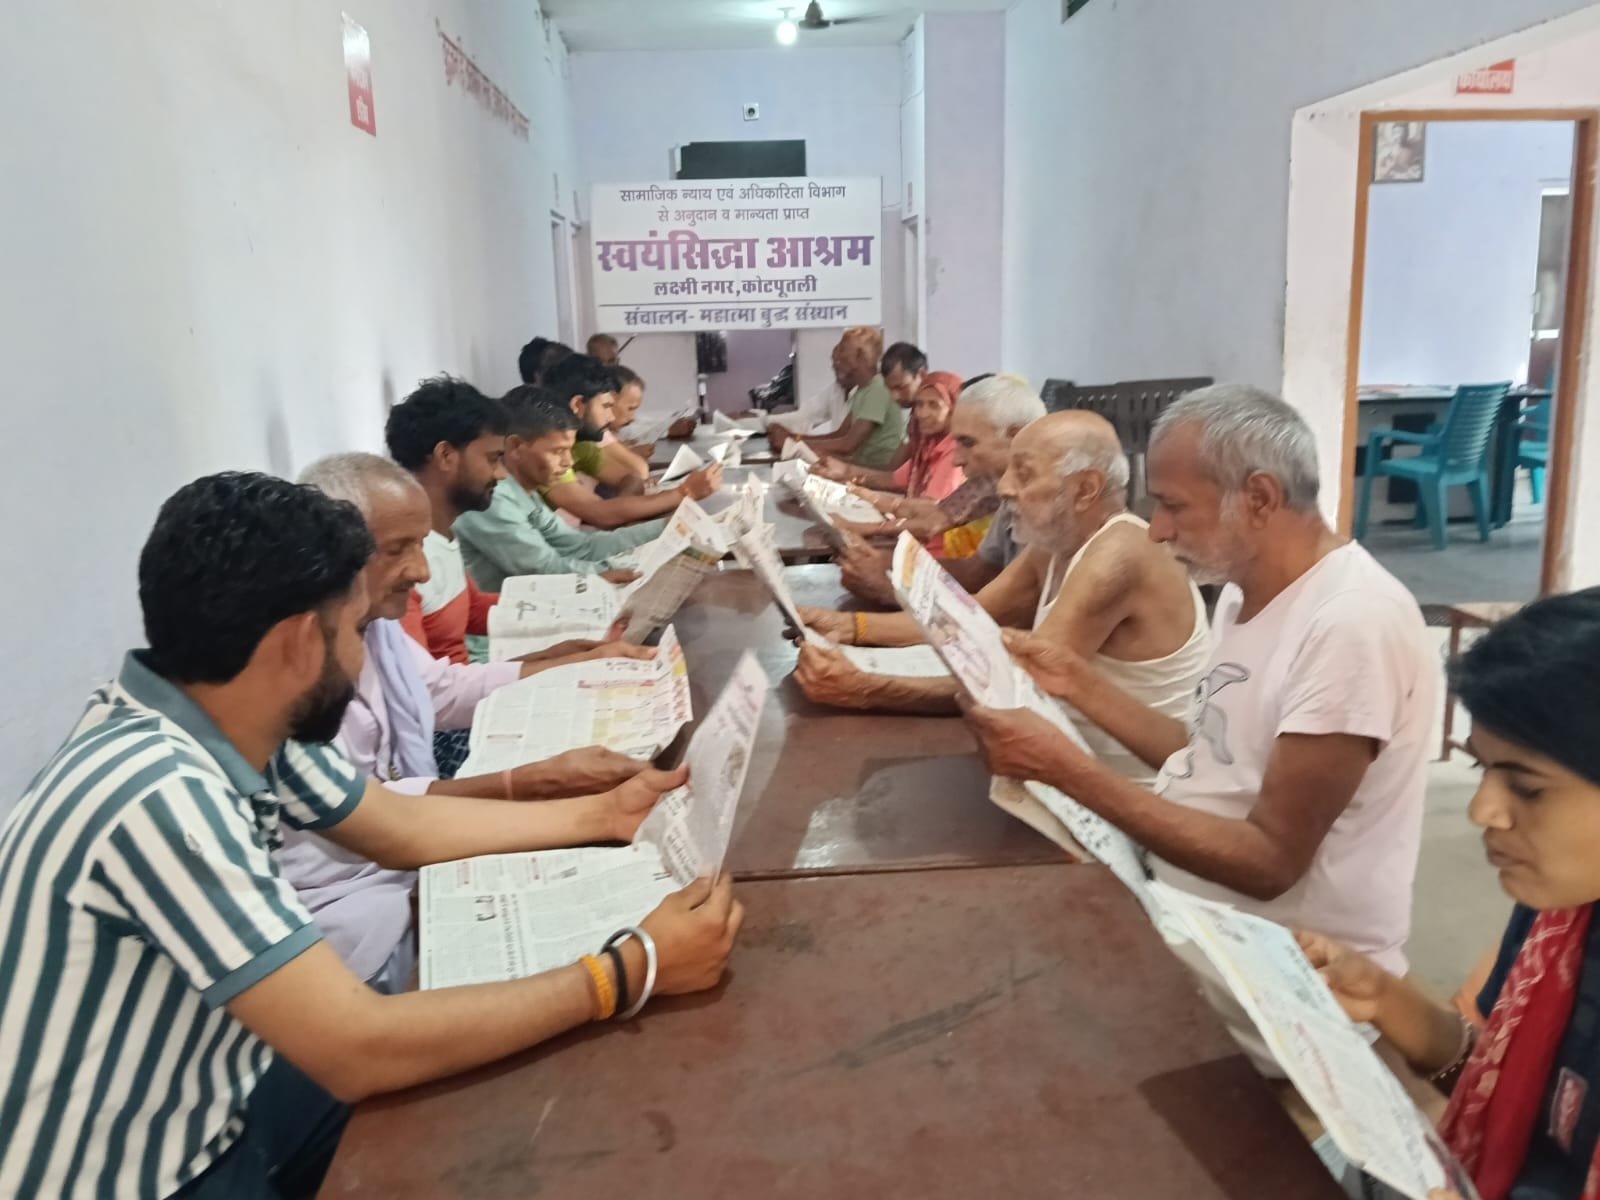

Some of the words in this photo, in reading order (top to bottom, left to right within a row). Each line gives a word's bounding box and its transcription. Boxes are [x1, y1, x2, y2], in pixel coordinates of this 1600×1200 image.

[619, 184, 678, 202] सामाजिक
[682, 189, 712, 201] न्याय
[716, 184, 735, 201] एवं
[739, 182, 804, 200] अधिकारिता
[808, 181, 846, 199] विभाग
[657, 205, 669, 222] से
[673, 209, 718, 226] अनुदान
[722, 209, 731, 221] व
[734, 208, 778, 221] मान्यता
[783, 207, 810, 221] प्राप्त
[596, 230, 759, 271] स्वयंसिद्धा
[766, 235, 875, 269] आश्रम
[653, 277, 698, 295] लक्ष्मी
[699, 307, 755, 323] महात्मा
[760, 304, 790, 327] बुद्ध
[795, 301, 848, 321] संस्थान
